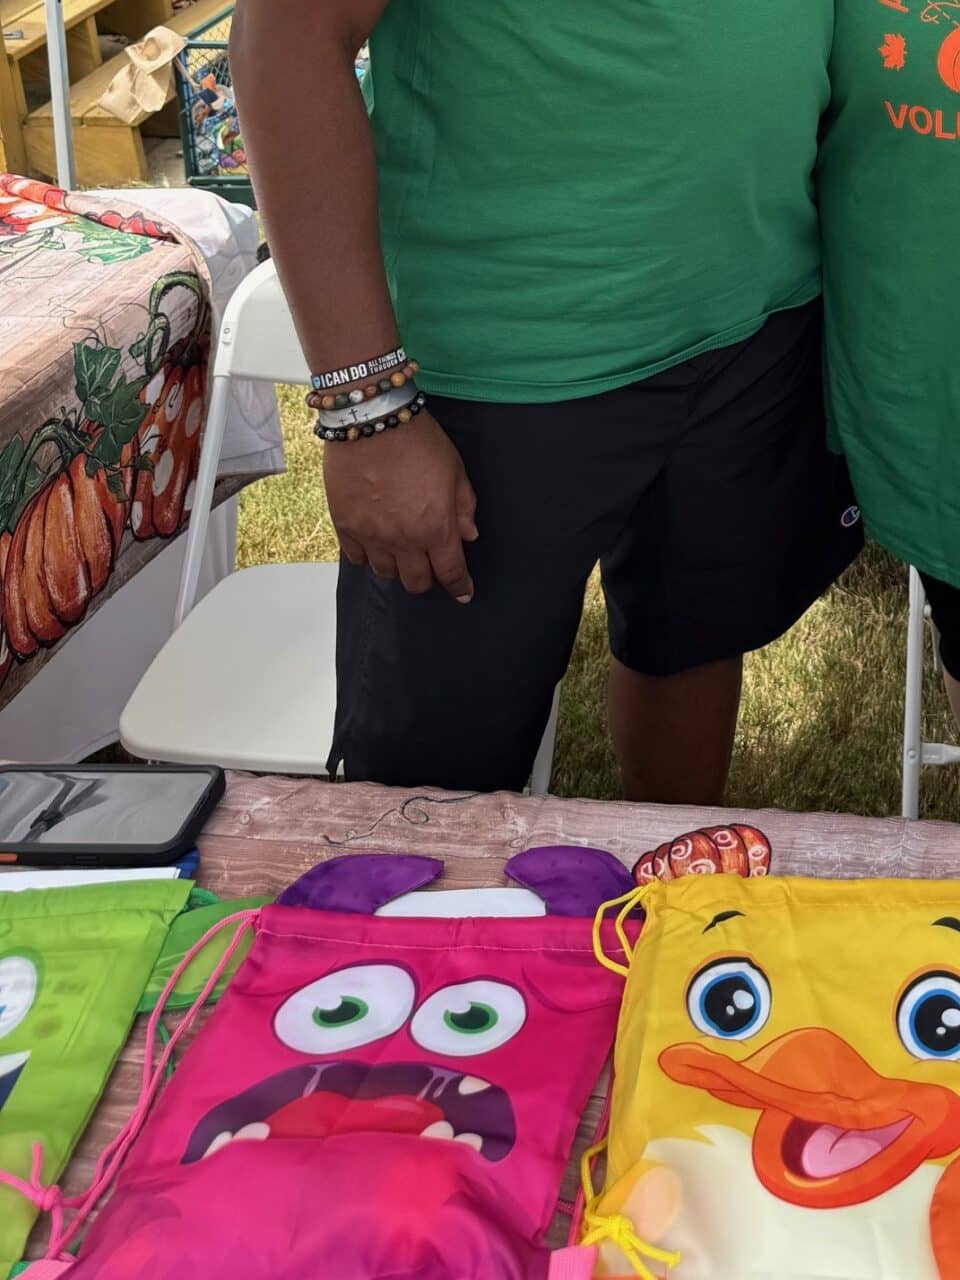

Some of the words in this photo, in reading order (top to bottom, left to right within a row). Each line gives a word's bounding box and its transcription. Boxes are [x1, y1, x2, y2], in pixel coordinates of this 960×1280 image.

[320, 375, 326, 388] I
[325, 370, 350, 387] CAN
[350, 363, 368, 380] DO
